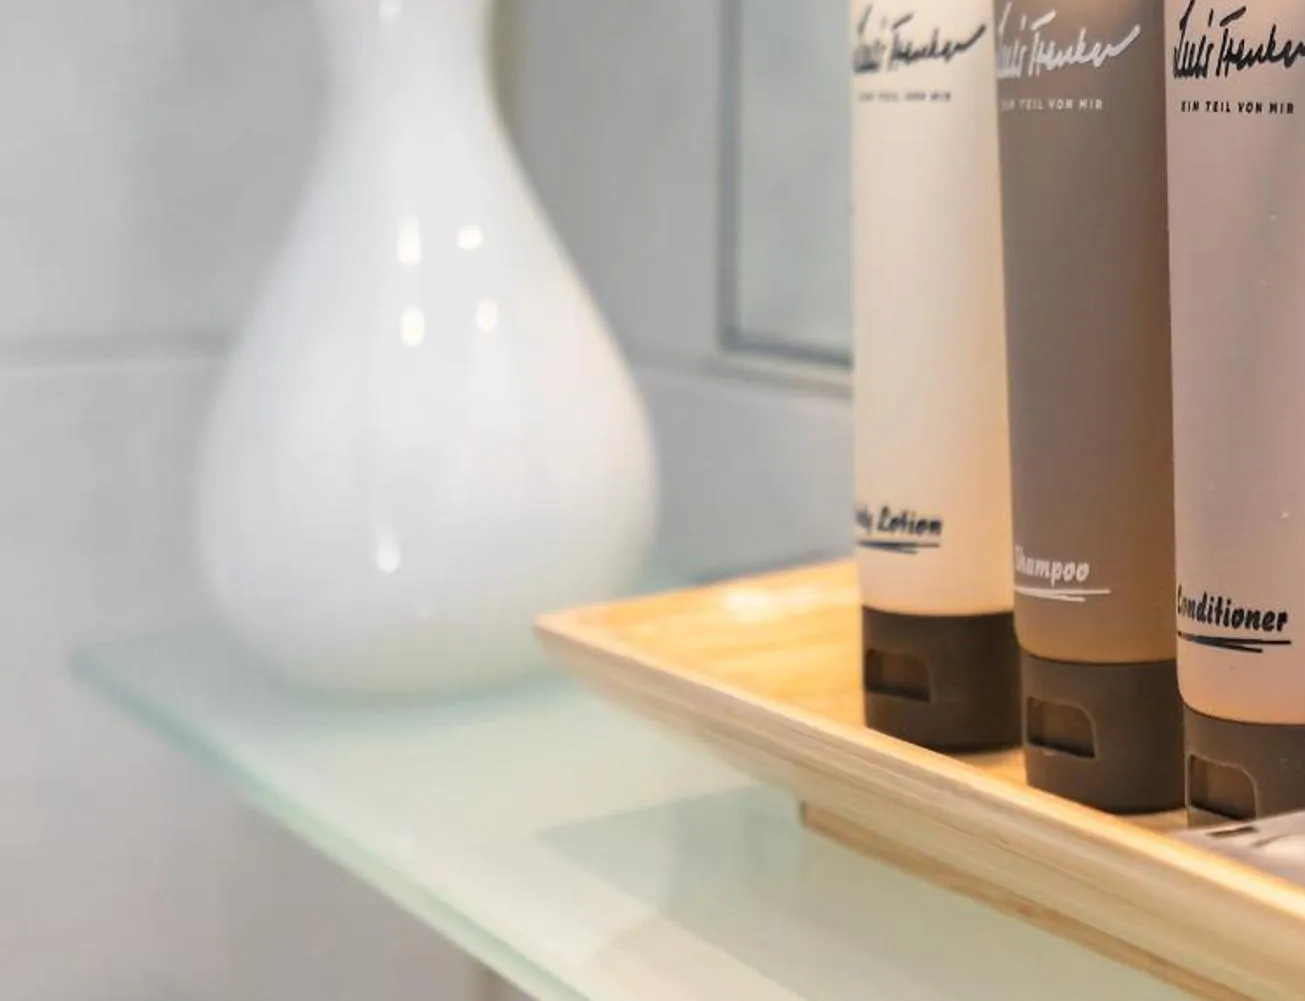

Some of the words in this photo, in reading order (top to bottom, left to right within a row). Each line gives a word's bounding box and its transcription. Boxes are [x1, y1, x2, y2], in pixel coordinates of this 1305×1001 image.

[1048, 99, 1074, 111] VON
[1079, 99, 1103, 111] MIR
[1180, 100, 1200, 113] EIN
[1204, 100, 1231, 114] TEIL
[1238, 101, 1263, 114] VON
[1268, 102, 1294, 115] MIR
[877, 505, 943, 538] Lotion
